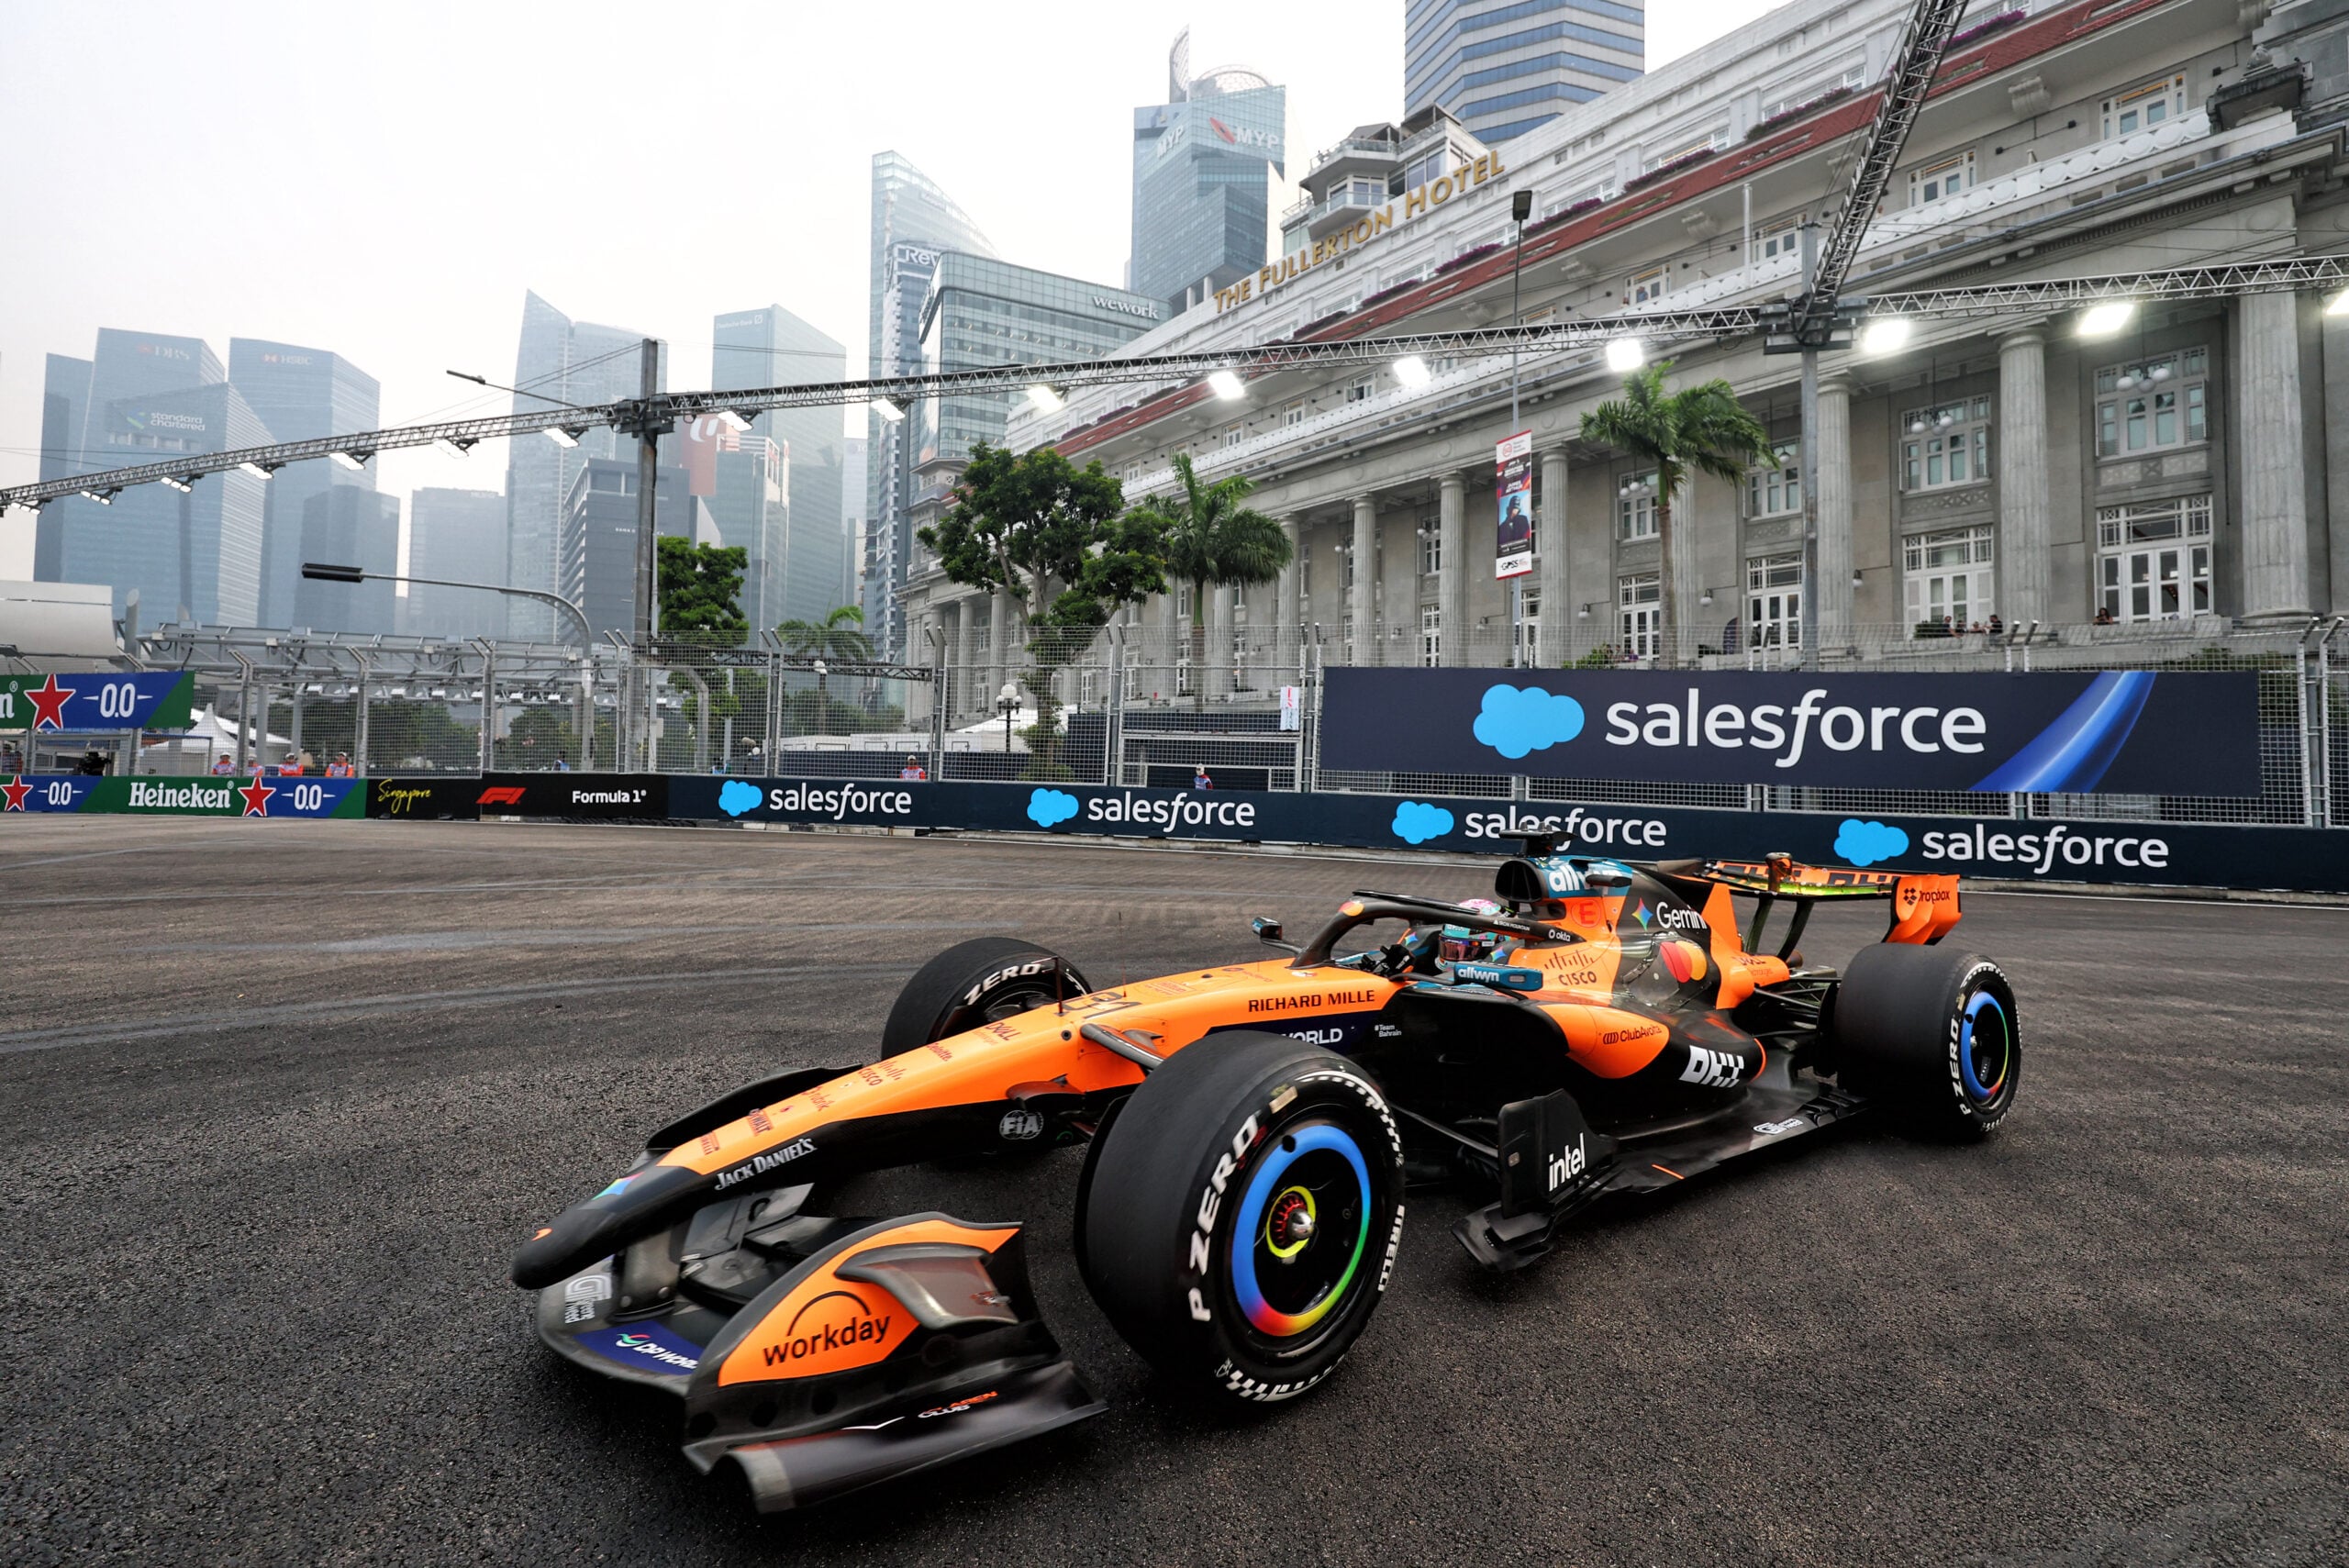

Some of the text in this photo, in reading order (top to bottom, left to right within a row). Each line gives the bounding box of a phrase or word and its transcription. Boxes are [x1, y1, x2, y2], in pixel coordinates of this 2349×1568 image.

[1156, 126, 1185, 159] MYP
[1237, 127, 1280, 149] MYP
[1213, 150, 1505, 313] THE FULLERTON HOTEL
[1092, 295, 1158, 320] wework
[154, 346, 190, 361] DBS
[281, 354, 314, 365] HSBC
[150, 412, 203, 425] standard
[150, 418, 206, 431] chartered
[100, 683, 136, 717] 0.0
[1605, 688, 1987, 769] salesforce
[48, 781, 72, 806] 0.0
[294, 784, 322, 810] 0.0
[377, 779, 432, 814] Singapore
[573, 790, 629, 804] Formula
[769, 783, 913, 820] salesforce
[1087, 792, 1255, 833] salesforce
[1922, 824, 2168, 873] salesforce
[1549, 863, 1622, 896] all
[1556, 930, 1571, 942] okta
[964, 963, 1042, 1006] ZERO
[1457, 966, 1500, 984] allwyn
[1559, 971, 1598, 986] CISCO
[1249, 990, 1375, 1013] RICHARD MILLE
[1285, 1028, 1343, 1045] ORLD
[858, 1068, 884, 1086] CISCO
[1949, 1018, 1972, 1116] P ZERO
[714, 1138, 818, 1191] JACK DANIEL'S
[1549, 1132, 1586, 1192] intel
[1188, 1114, 1259, 1321] P ZERO
[1377, 1205, 1405, 1292] PIRELLI
[763, 1316, 890, 1367] workday
[652, 1351, 699, 1369] WORL
